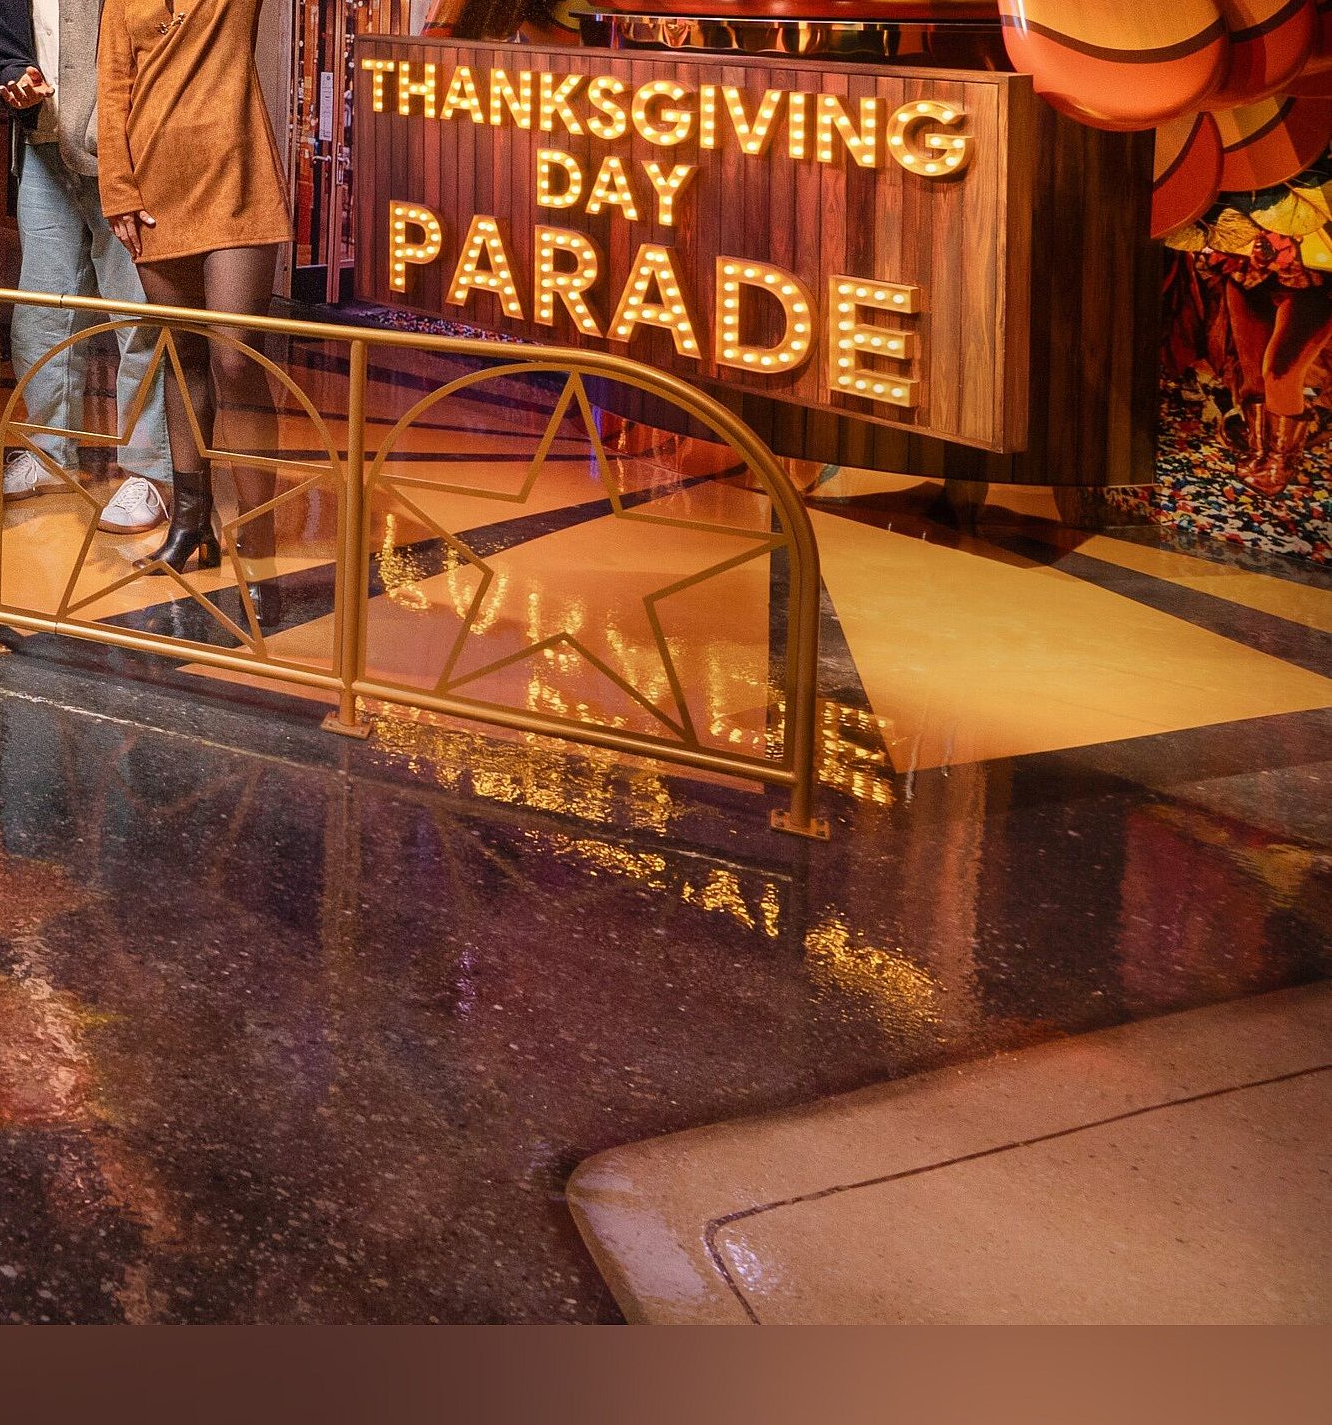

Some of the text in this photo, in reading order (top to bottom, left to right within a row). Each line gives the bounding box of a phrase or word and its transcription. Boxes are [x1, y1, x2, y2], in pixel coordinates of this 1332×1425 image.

[361, 59, 973, 177] THANKSGIVING
[537, 148, 698, 226] DAY
[389, 200, 921, 407] PARADE
